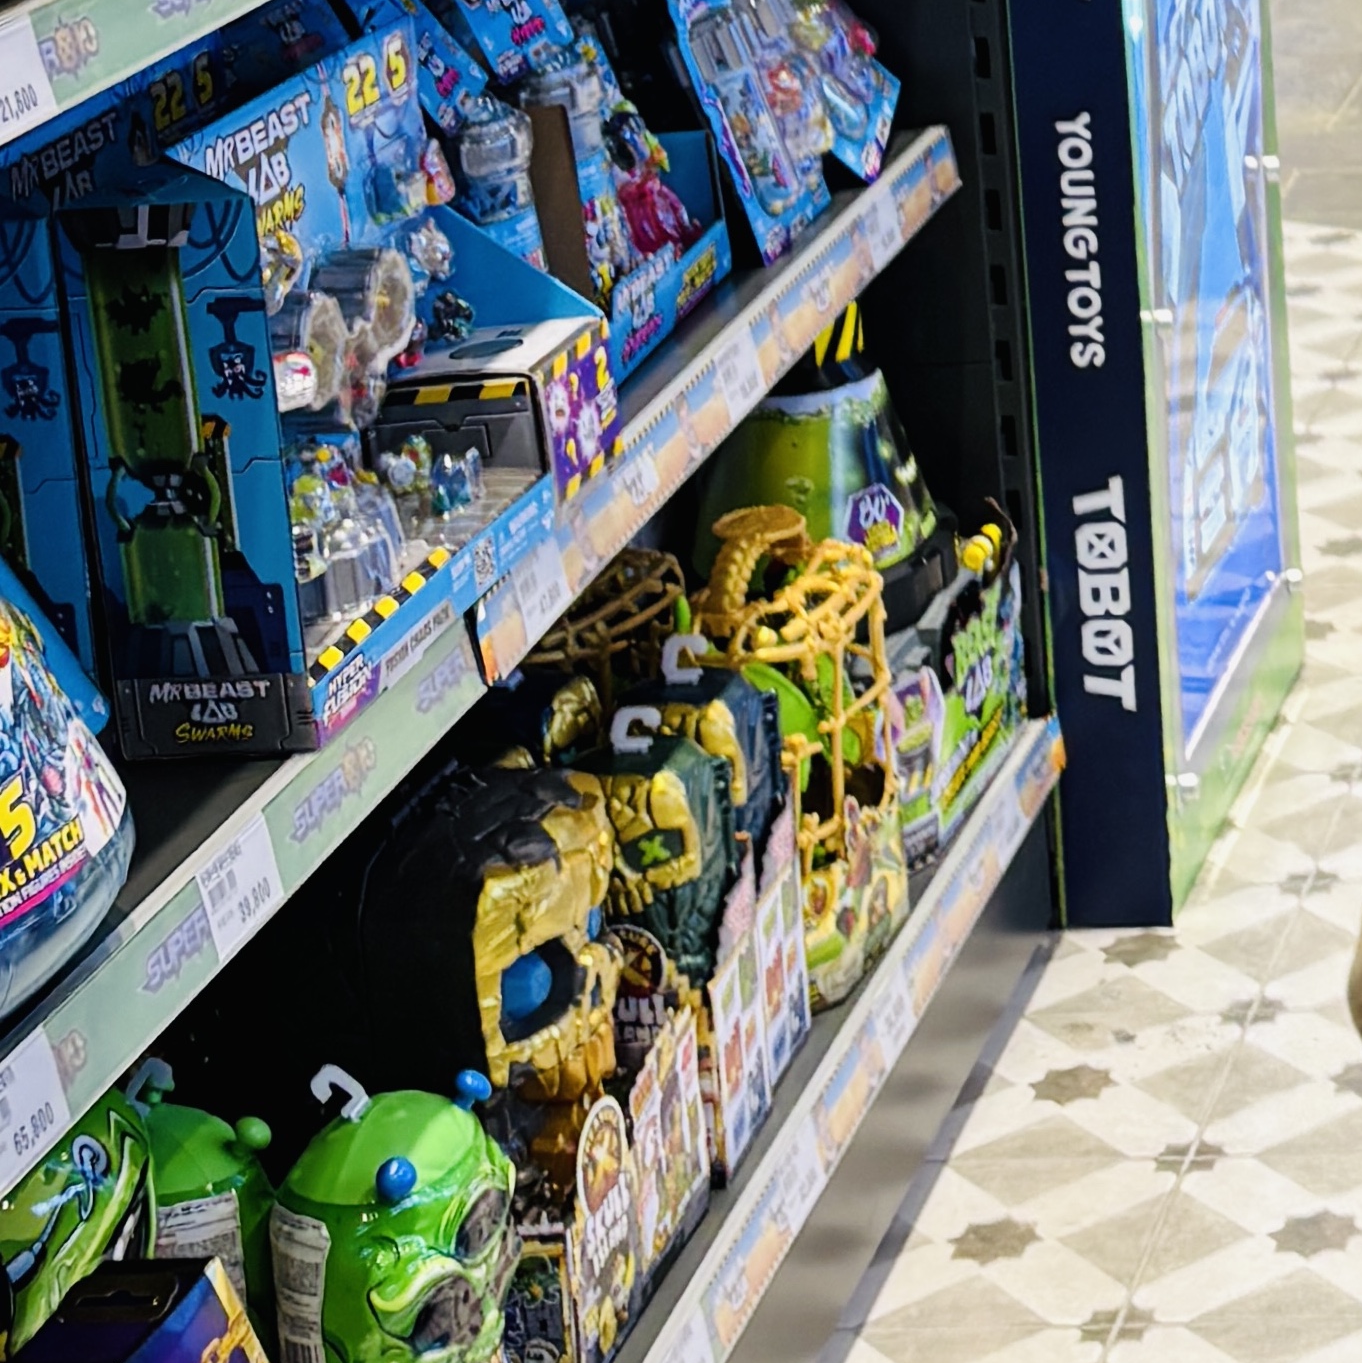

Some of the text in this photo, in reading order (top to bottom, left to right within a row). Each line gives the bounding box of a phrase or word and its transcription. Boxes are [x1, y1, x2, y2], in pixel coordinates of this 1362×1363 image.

[343, 37, 409, 117] 22 5
[204, 91, 313, 183] MRBEAST
[246, 149, 293, 207] LAB
[1070, 475, 1138, 713] TOBOT
[149, 679, 272, 704] MRBEAST
[327, 653, 365, 698] HYPER
[175, 720, 254, 744] SWARMS
[23, 816, 84, 880] MATCH
